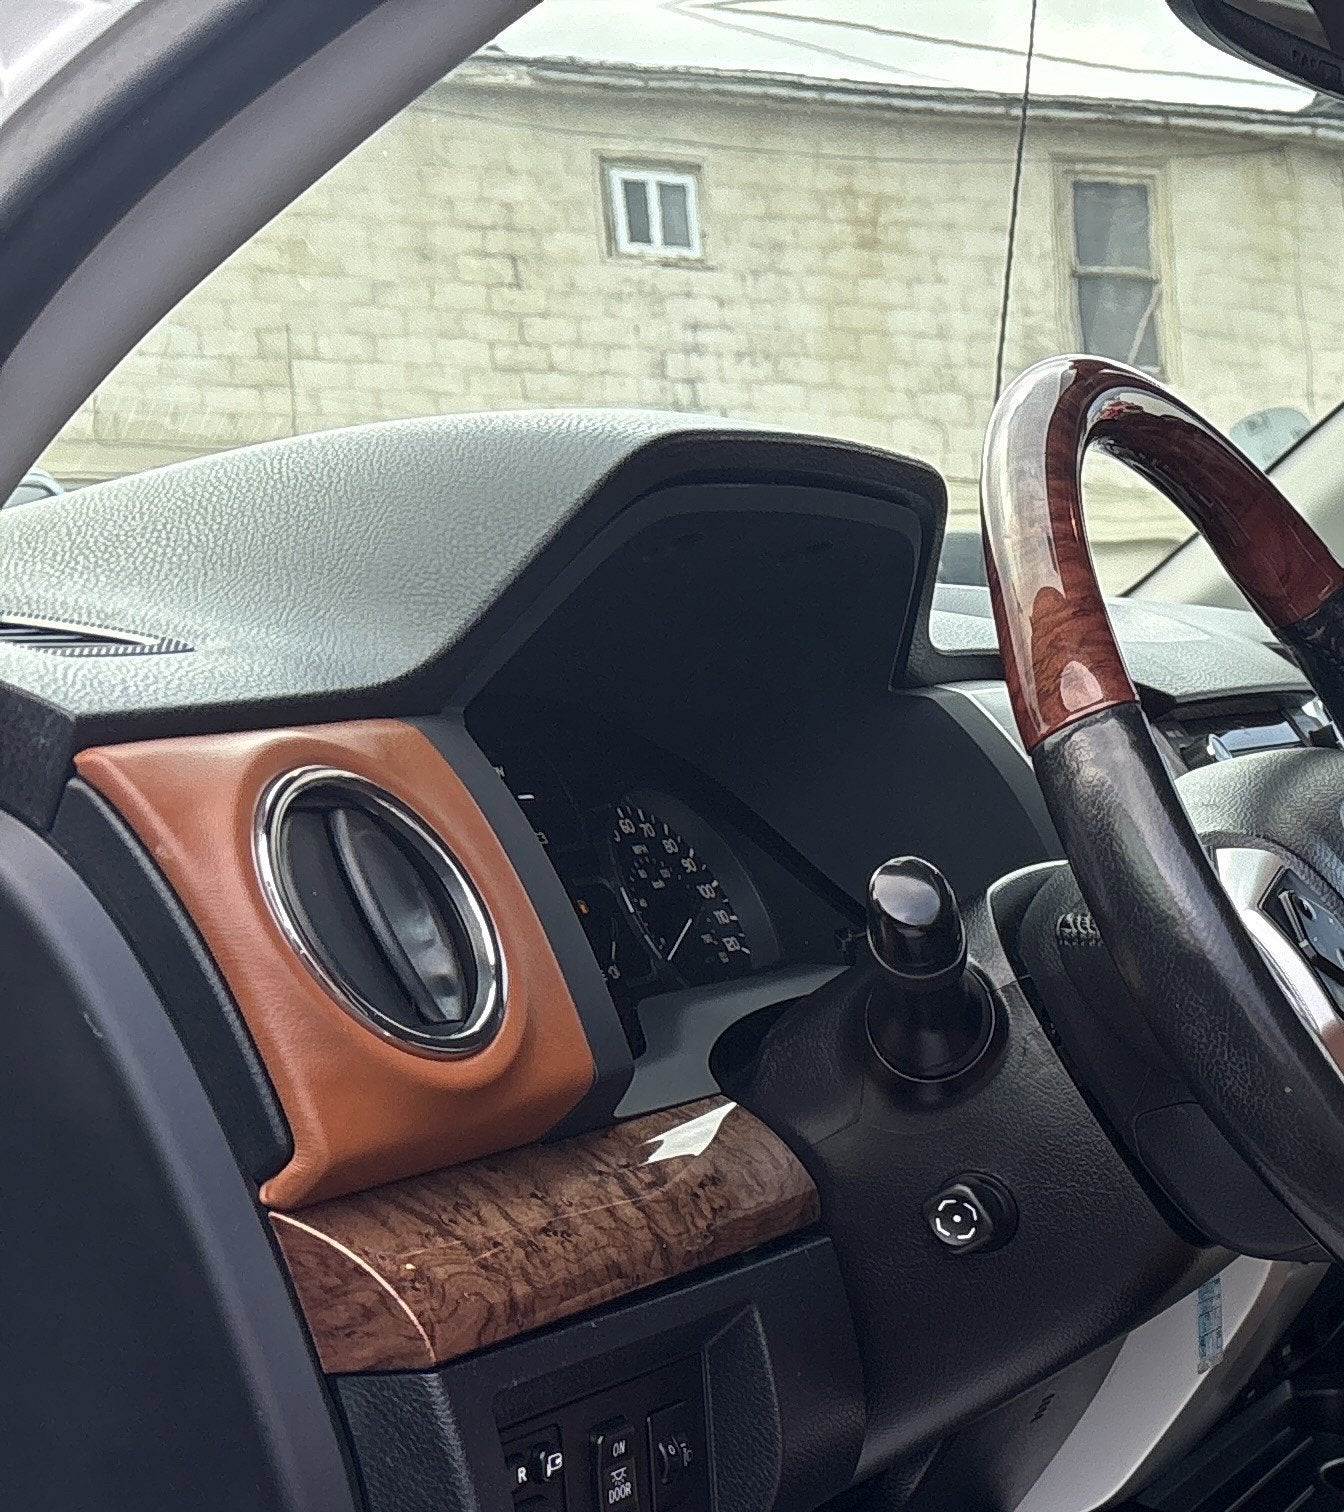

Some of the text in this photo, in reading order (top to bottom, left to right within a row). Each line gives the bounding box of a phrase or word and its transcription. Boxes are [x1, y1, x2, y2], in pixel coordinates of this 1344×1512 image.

[612, 1440, 626, 1457] ON
[517, 1467, 528, 1484] R
[608, 1482, 632, 1504] DOOR
